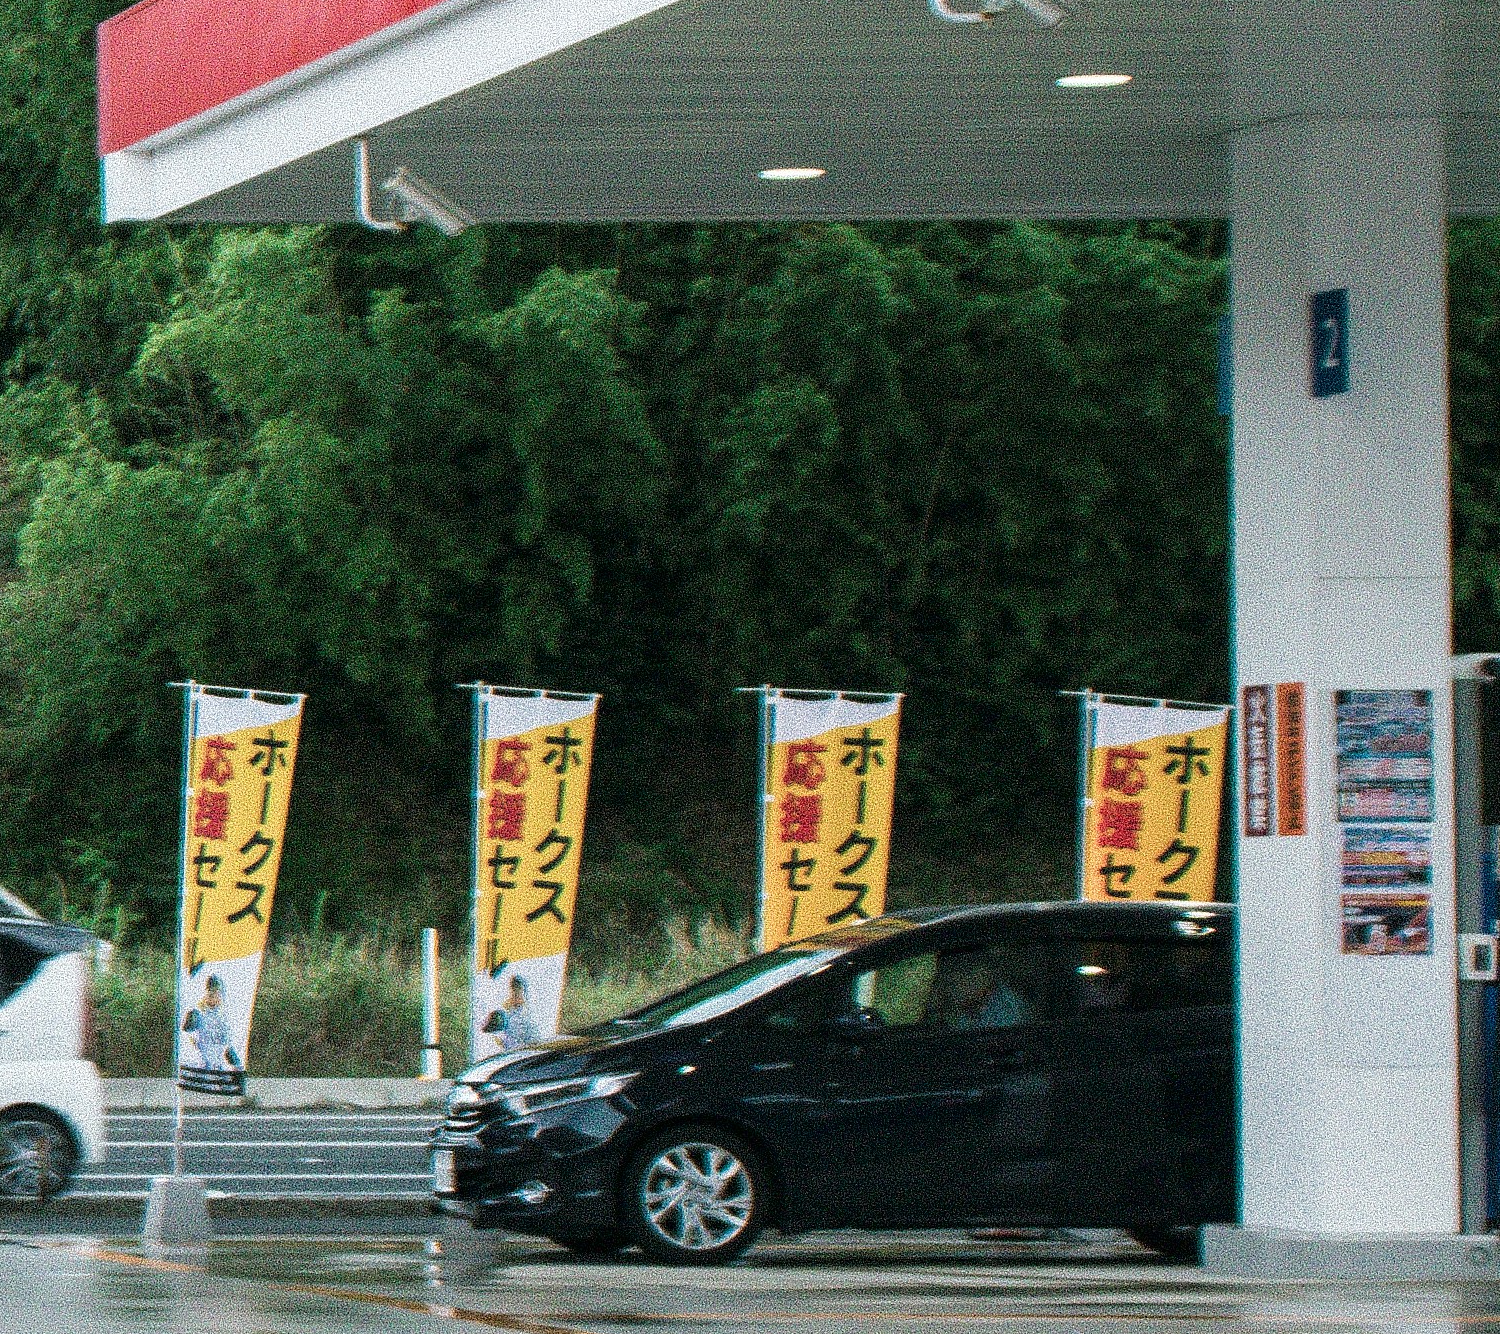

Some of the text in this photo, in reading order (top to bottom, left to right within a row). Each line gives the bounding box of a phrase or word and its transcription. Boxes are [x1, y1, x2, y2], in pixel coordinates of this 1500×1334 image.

[1324, 318, 1342, 368] 2
[226, 729, 289, 925] ホークス
[524, 727, 583, 925] ホークス
[779, 739, 829, 948] 応援セー
[825, 727, 885, 924] ホークス
[1154, 736, 1212, 900] ホーク
